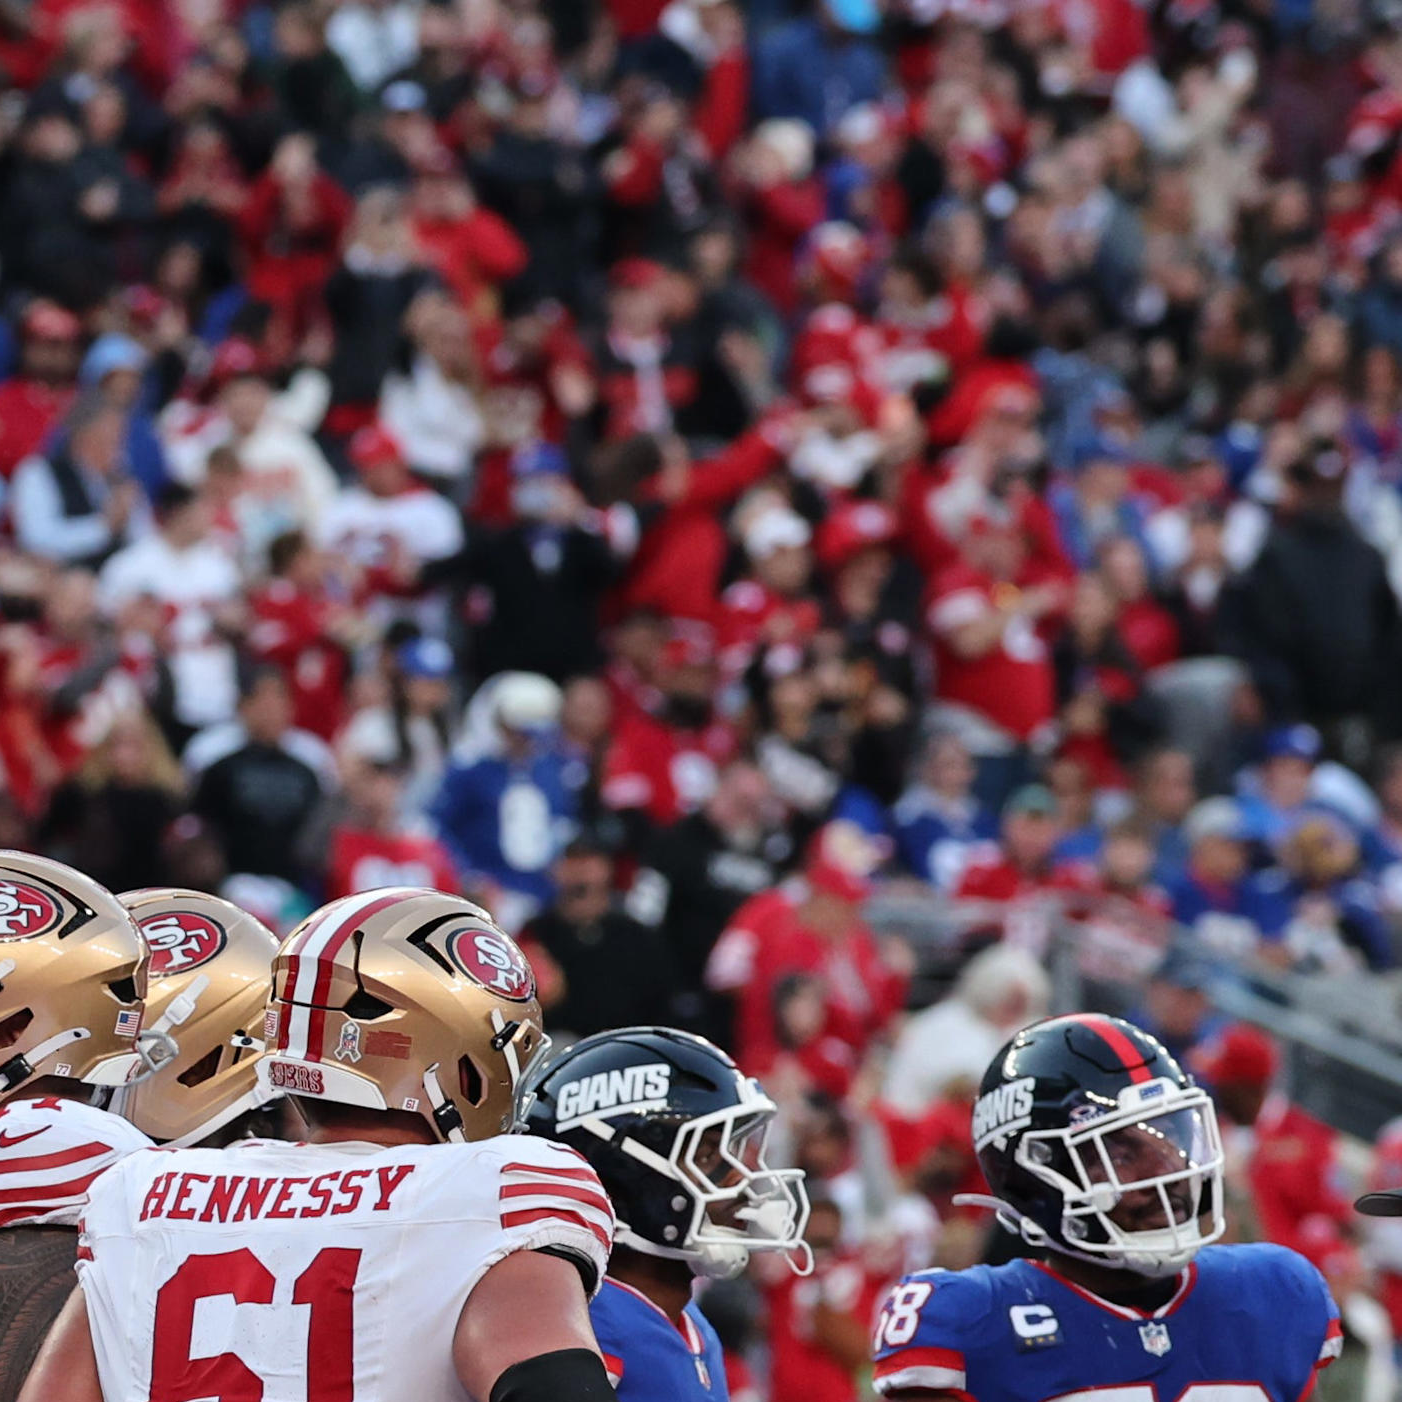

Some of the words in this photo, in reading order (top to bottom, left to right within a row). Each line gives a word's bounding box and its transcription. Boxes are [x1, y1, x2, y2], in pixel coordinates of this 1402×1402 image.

[557, 1064, 671, 1119] GIANTS
[139, 1164, 416, 1224] HENNESSY
[1010, 1304, 1058, 1338] C
